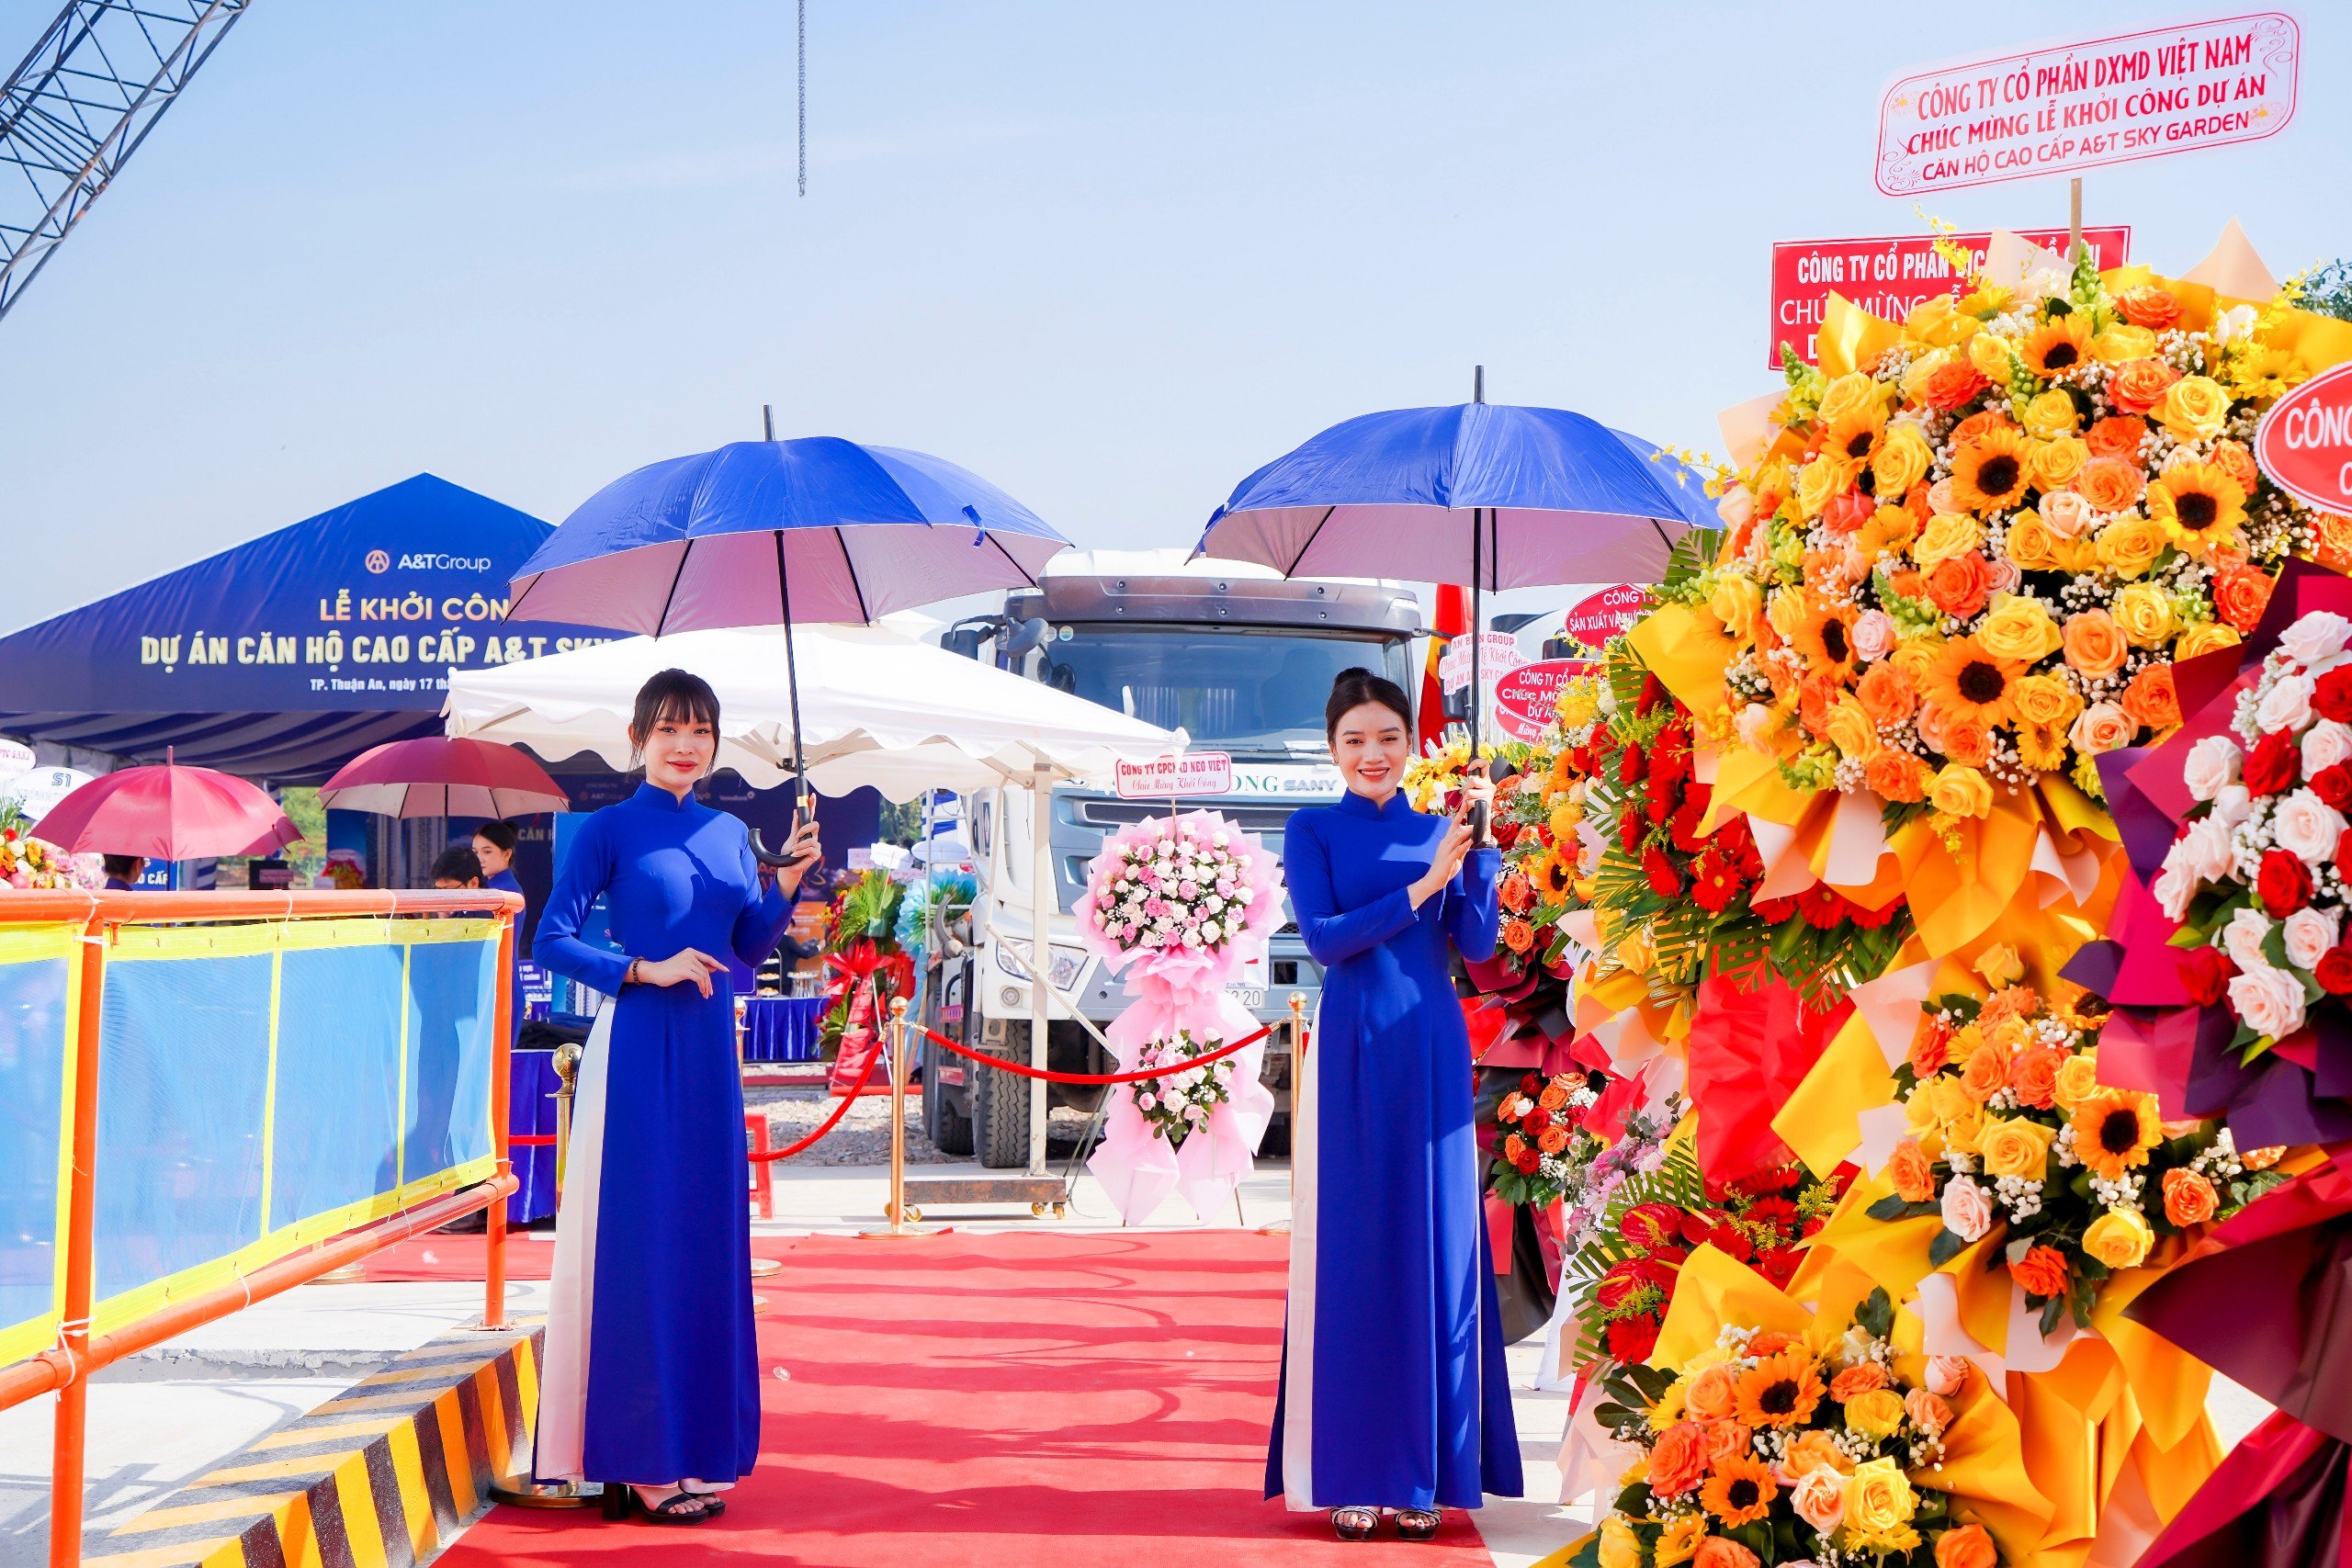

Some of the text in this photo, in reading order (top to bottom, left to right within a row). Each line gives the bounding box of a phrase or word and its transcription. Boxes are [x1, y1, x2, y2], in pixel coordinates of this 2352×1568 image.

[1917, 33, 2251, 120] CÔNG TY CỔ PHẦN DXMD VIỆT NAM
[1908, 72, 2266, 154] CHÚC MỪNG LỄ KHỞI CÔNG DỰ ÁN
[1922, 110, 2249, 180] CĂN HỘ CAO CẤP A&T SKY GARDEN
[1798, 250, 1844, 284] CÔNG
[1849, 254, 1870, 282] TY
[1873, 242, 1898, 281] CỔ
[1780, 292, 1829, 325] CHÚ
[397, 553, 492, 573] A&TGroup
[320, 588, 510, 621] LỄ KHỞI CÔN
[1603, 589, 1639, 605] CÔNG
[1569, 611, 1586, 632] SẢN
[1588, 610, 1608, 631] XUẤT
[141, 634, 182, 674] DỰ
[187, 630, 229, 664] ÁN
[237, 631, 297, 664] CĂN
[306, 629, 344, 672] HỘ
[352, 634, 410, 663] CAO
[418, 626, 476, 663] CẤP
[483, 636, 548, 663] A&T
[1488, 634, 1515, 647] GROUP
[310, 678, 329, 691] TP.
[331, 678, 365, 693] Thuận
[367, 679, 387, 692] An,
[389, 678, 416, 692] ngày
[420, 678, 433, 690] 17
[1519, 669, 1544, 686] CÔNG
[1545, 672, 1555, 686] TY
[1145, 762, 1155, 775] TY
[1190, 761, 1206, 773] NEO
[1208, 757, 1227, 774] VIỆT
[1283, 779, 1338, 792] SANY
